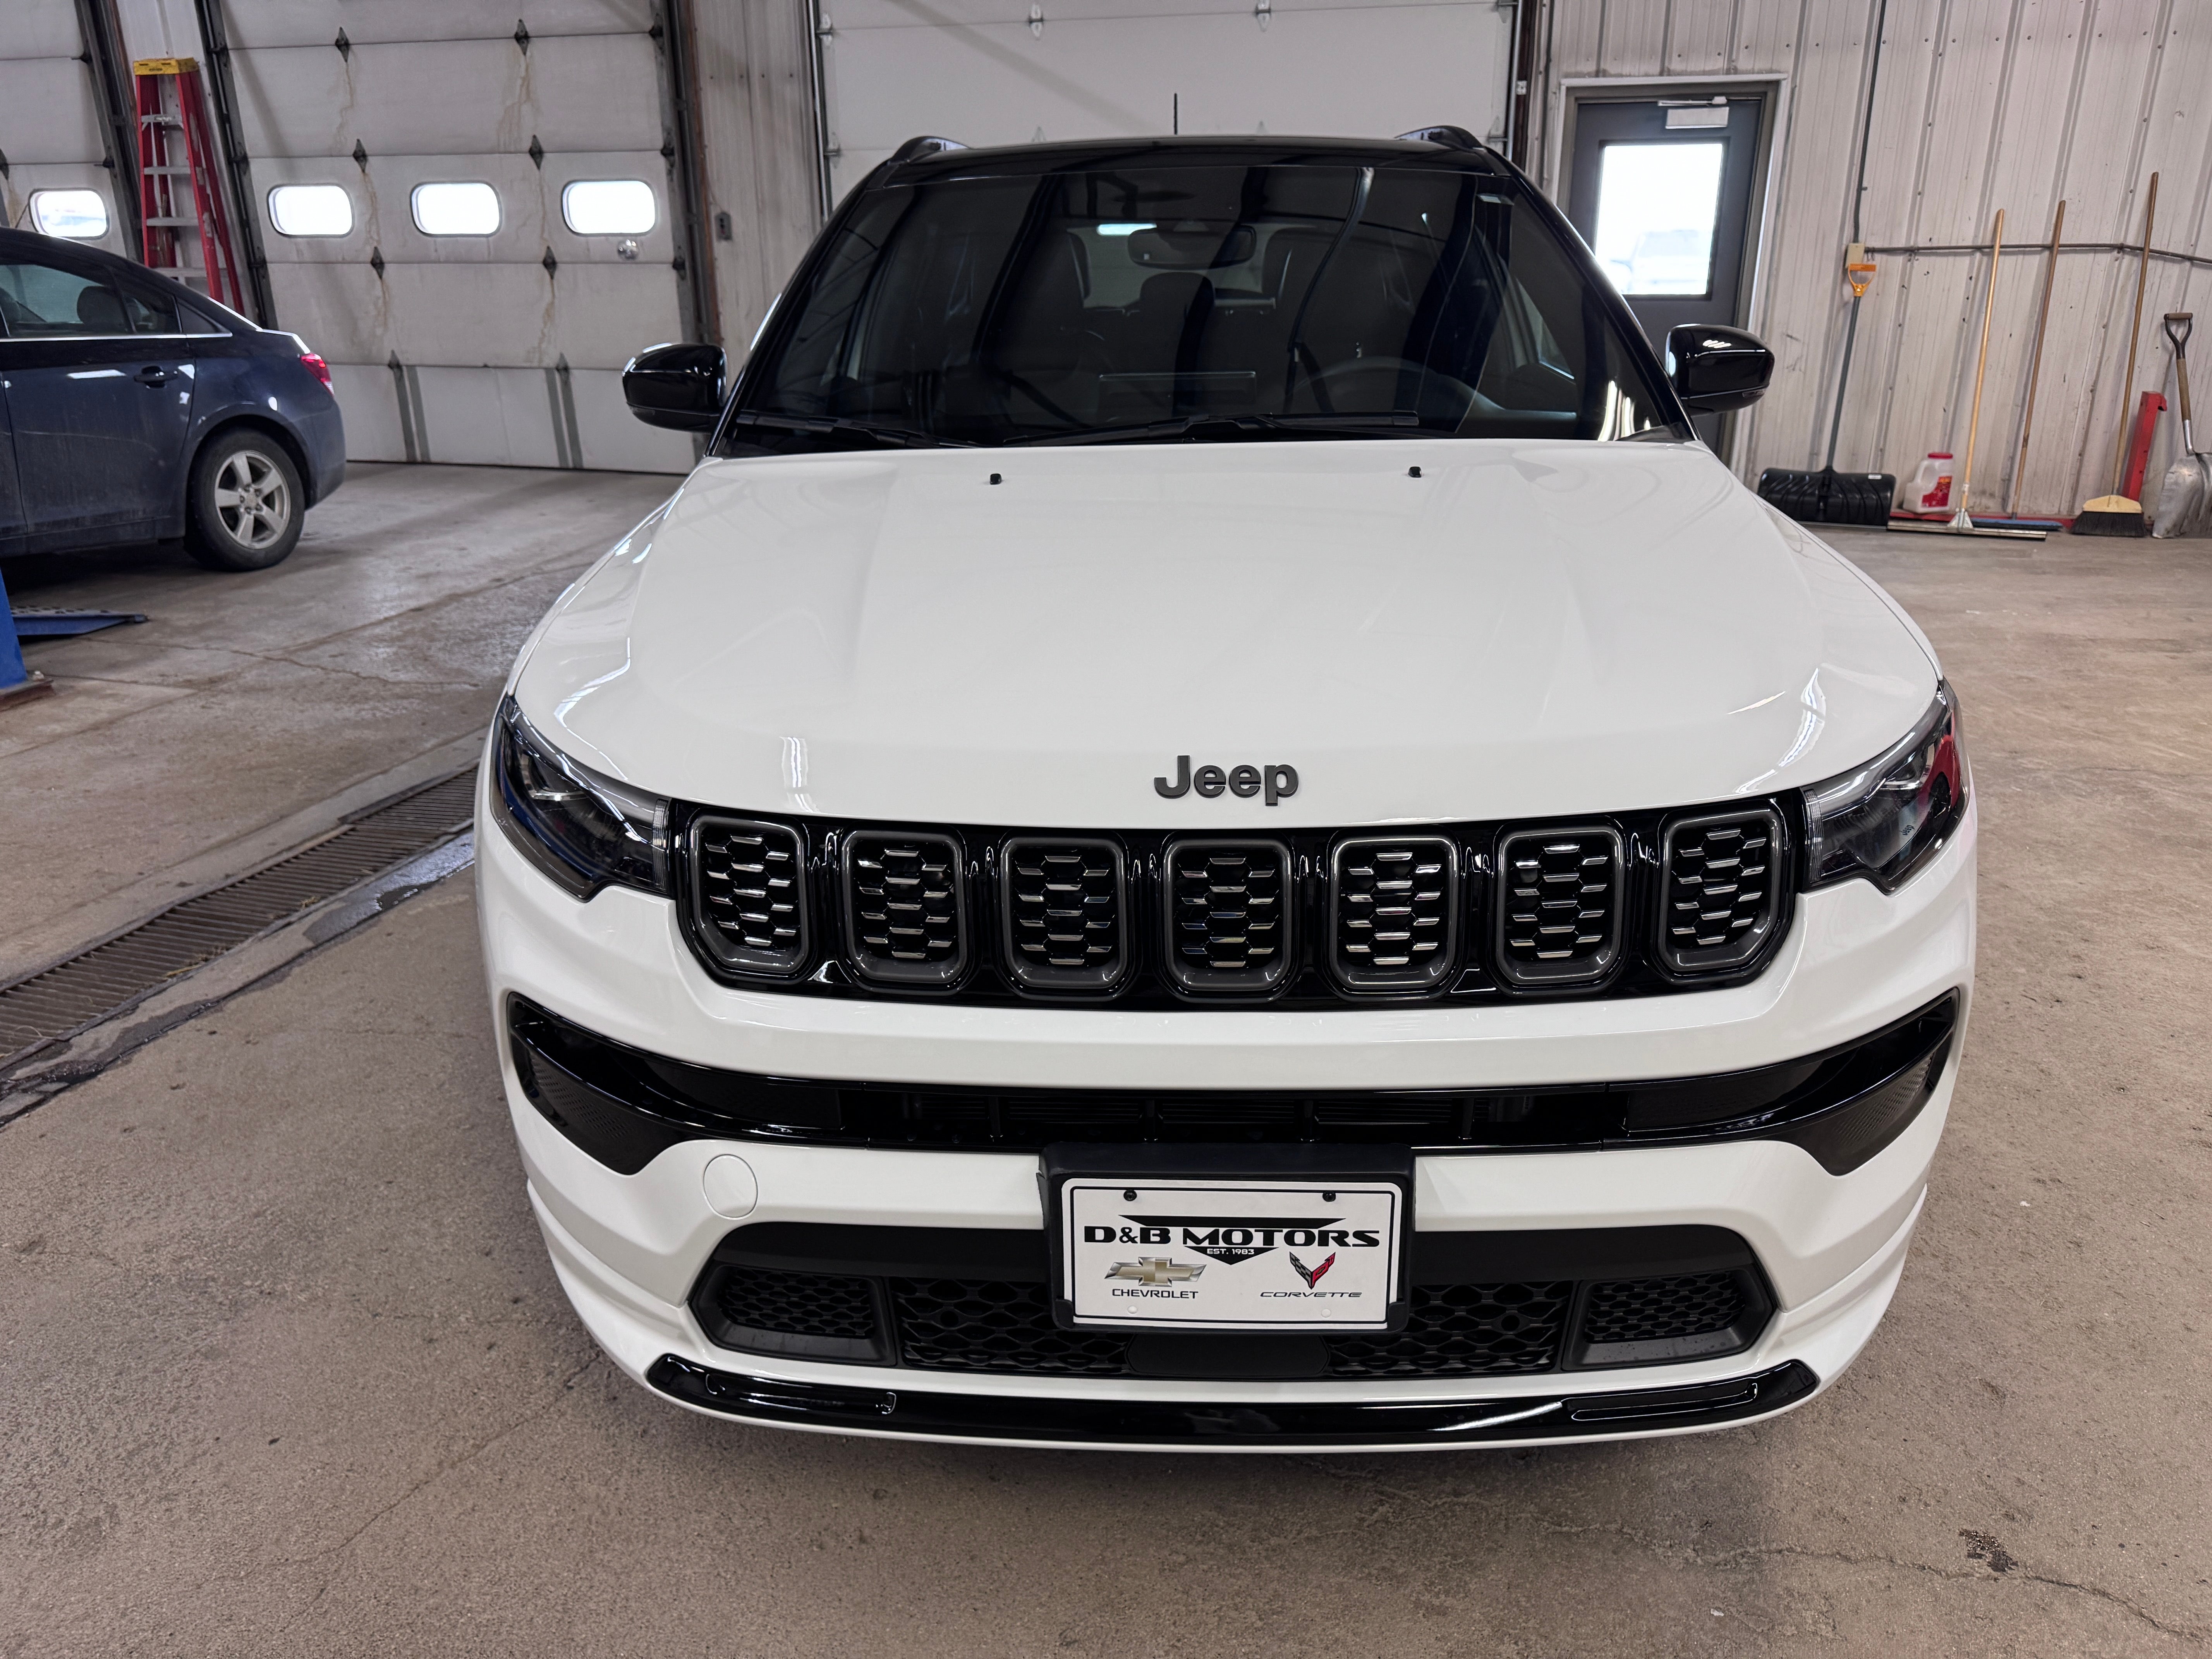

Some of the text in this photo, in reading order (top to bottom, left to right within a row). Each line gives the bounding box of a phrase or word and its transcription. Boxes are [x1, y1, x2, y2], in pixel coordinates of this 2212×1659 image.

[1154, 755, 1299, 806] Jeep
[1084, 1226, 1380, 1247] D&B MOTORS
[1112, 1288, 1199, 1299] CHEVROLET
